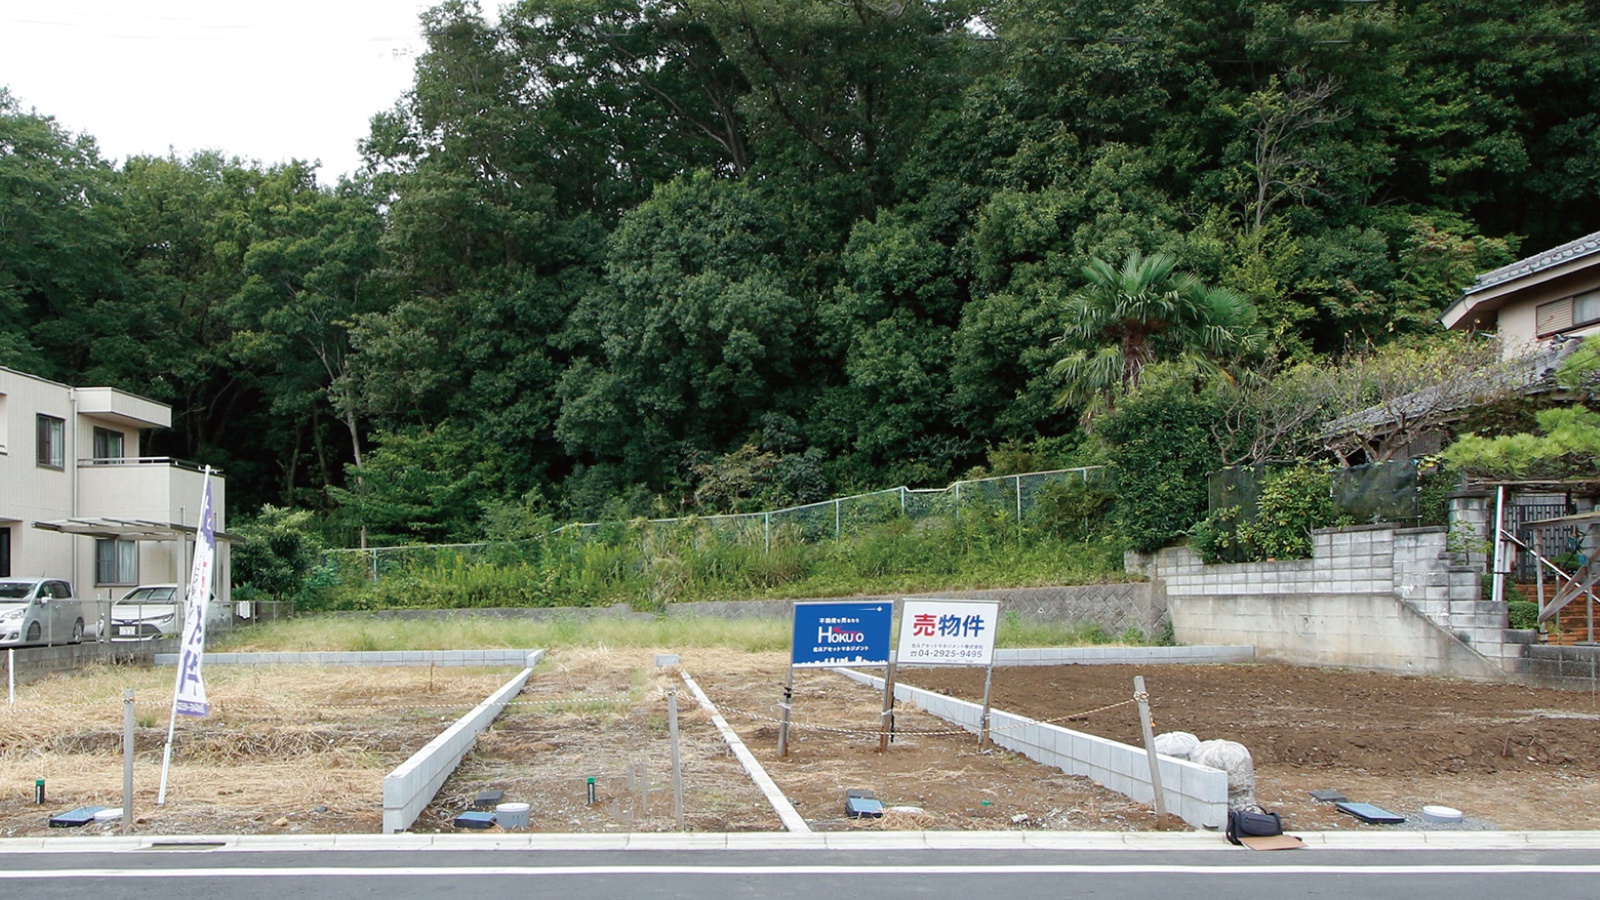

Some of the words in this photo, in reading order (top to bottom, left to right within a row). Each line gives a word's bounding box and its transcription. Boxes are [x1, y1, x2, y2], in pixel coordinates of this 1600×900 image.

[913, 613, 985, 637] 売物件
[918, 649, 983, 658] 04-2925-9495
